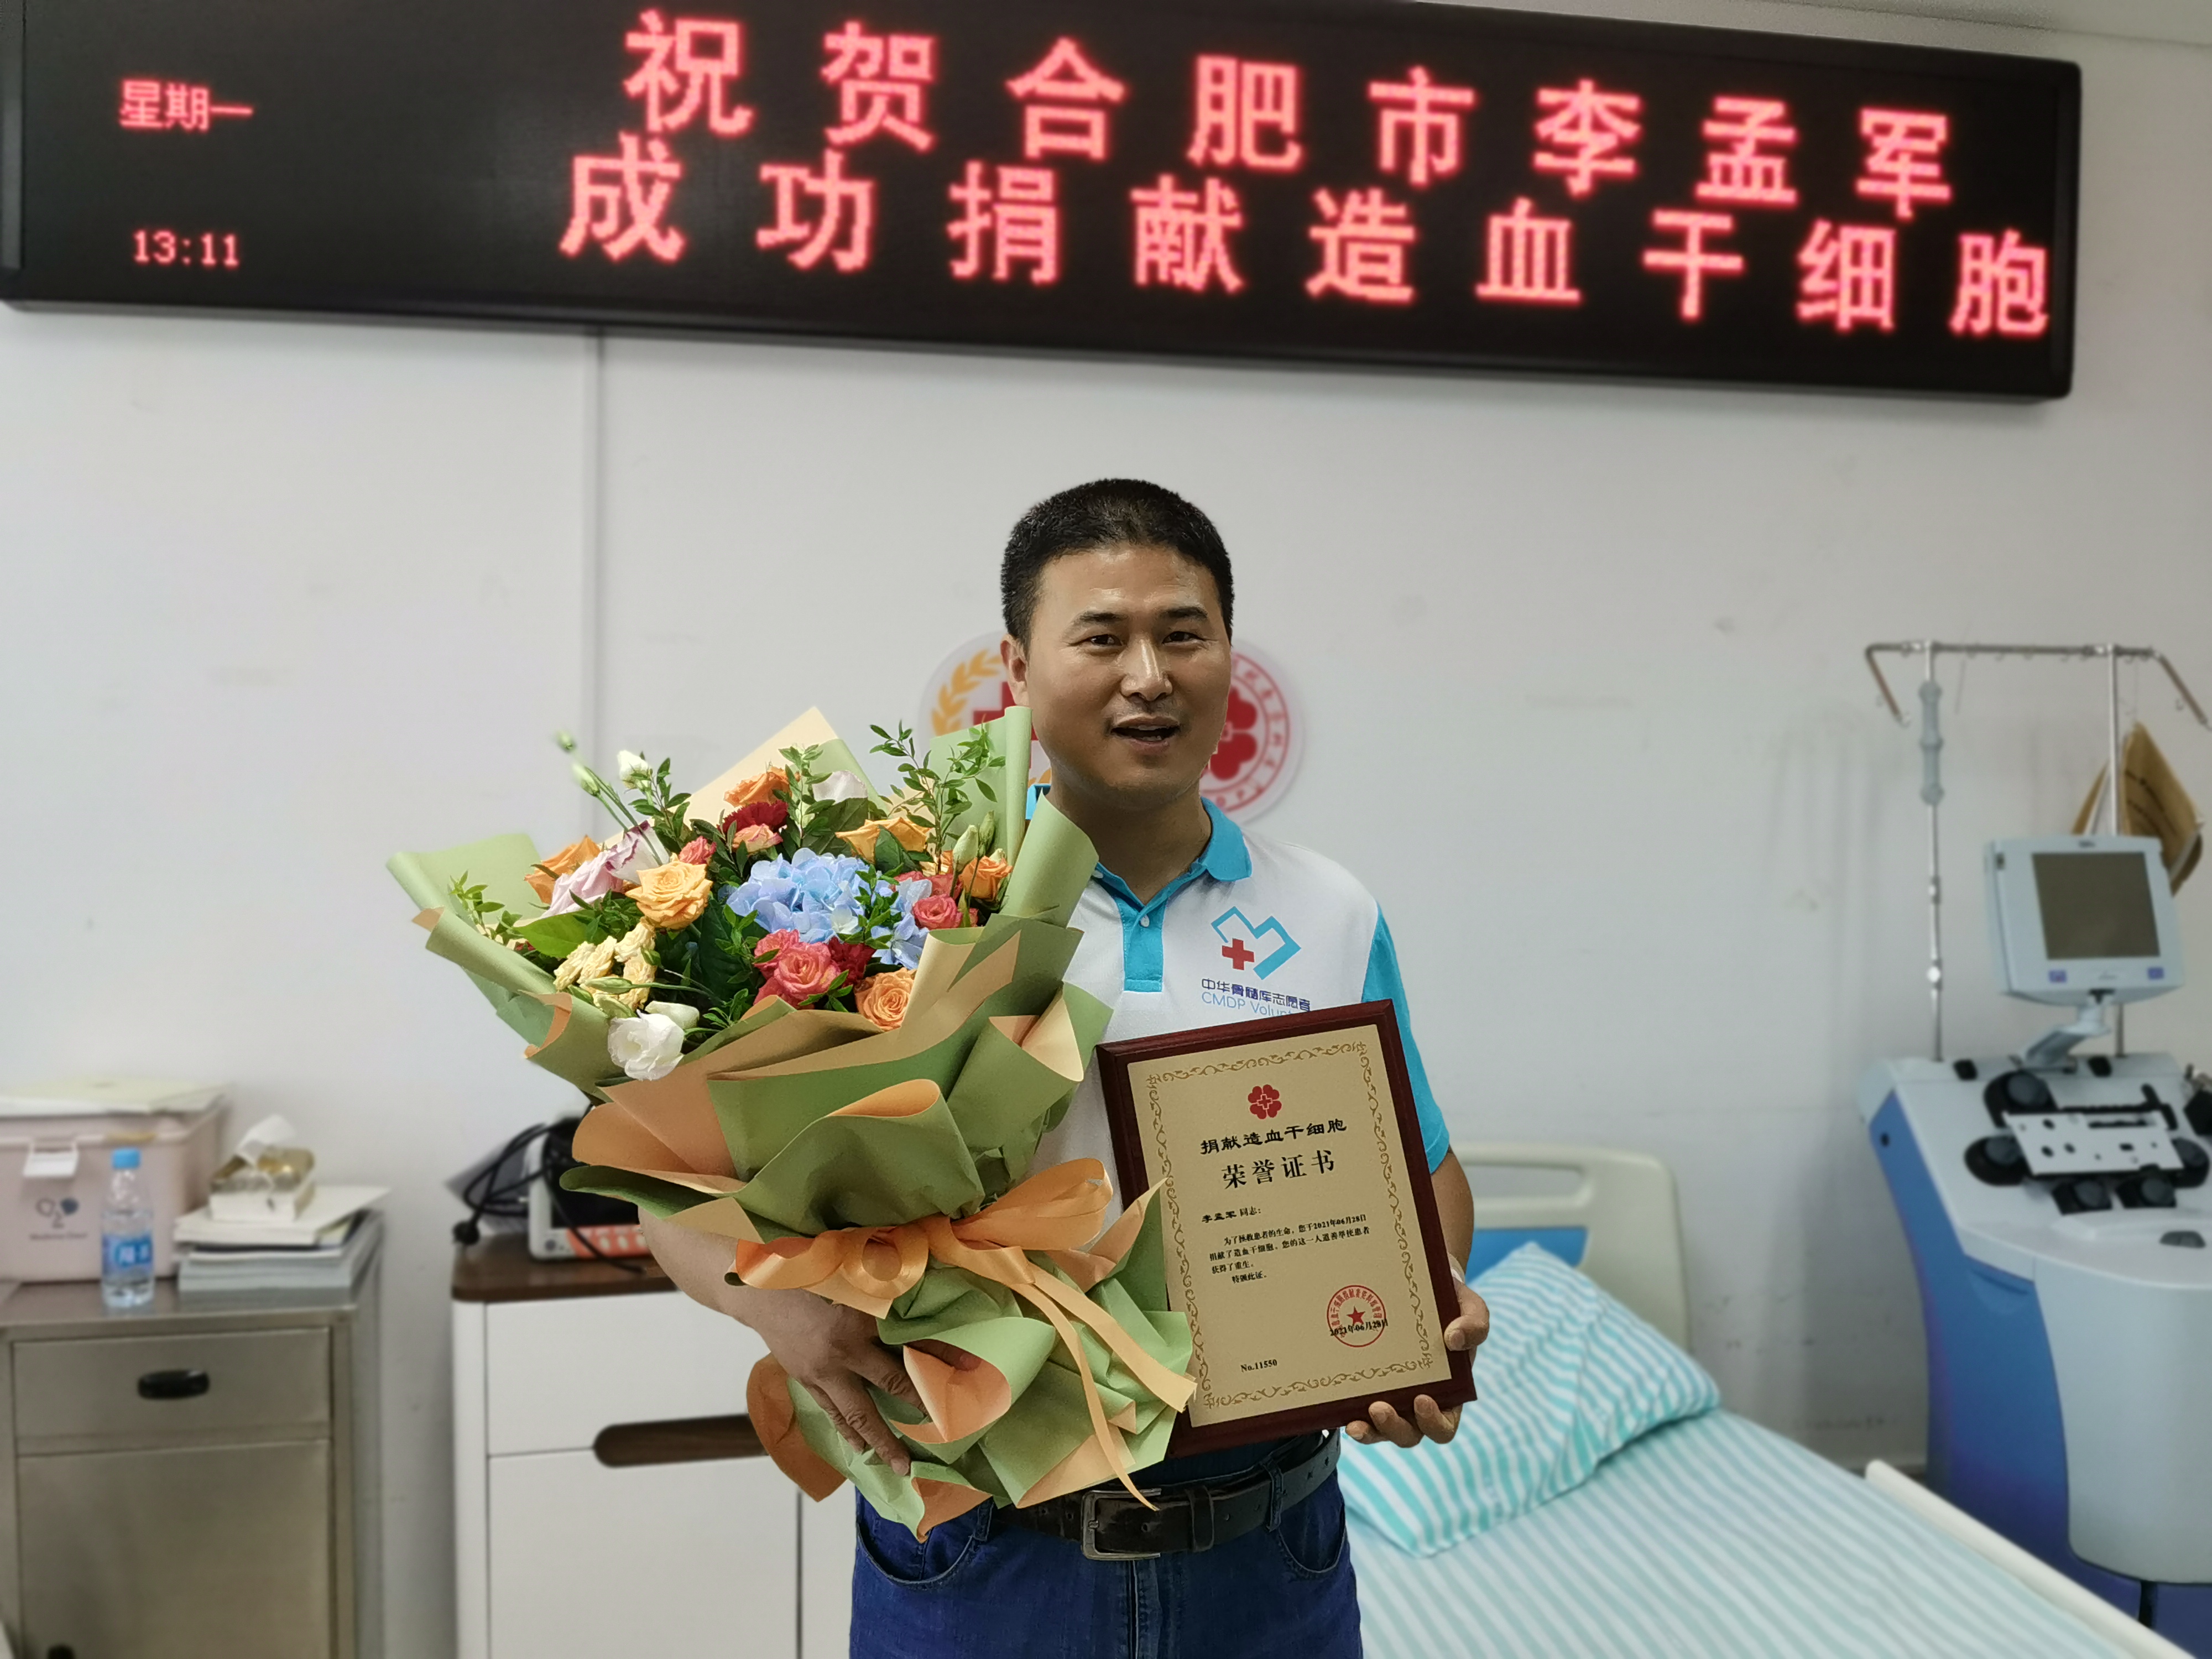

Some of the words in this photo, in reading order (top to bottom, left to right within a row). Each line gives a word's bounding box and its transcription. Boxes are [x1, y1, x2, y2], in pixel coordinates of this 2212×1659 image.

[119, 79, 253, 131] 星期一
[625, 8, 1951, 220] 祝贺合肥市李孟军
[135, 231, 238, 267] 13:11
[560, 133, 2048, 335] 成功捐献造血干细胞
[1202, 978, 1311, 1012] 中华骨髓库志愿者
[1202, 992, 1245, 1010] CMDP
[1200, 1119, 1347, 1155] 捐献造血干细胞
[1222, 1150, 1334, 1190] 荣誉证书
[1240, 1359, 1277, 1373] No.11550
